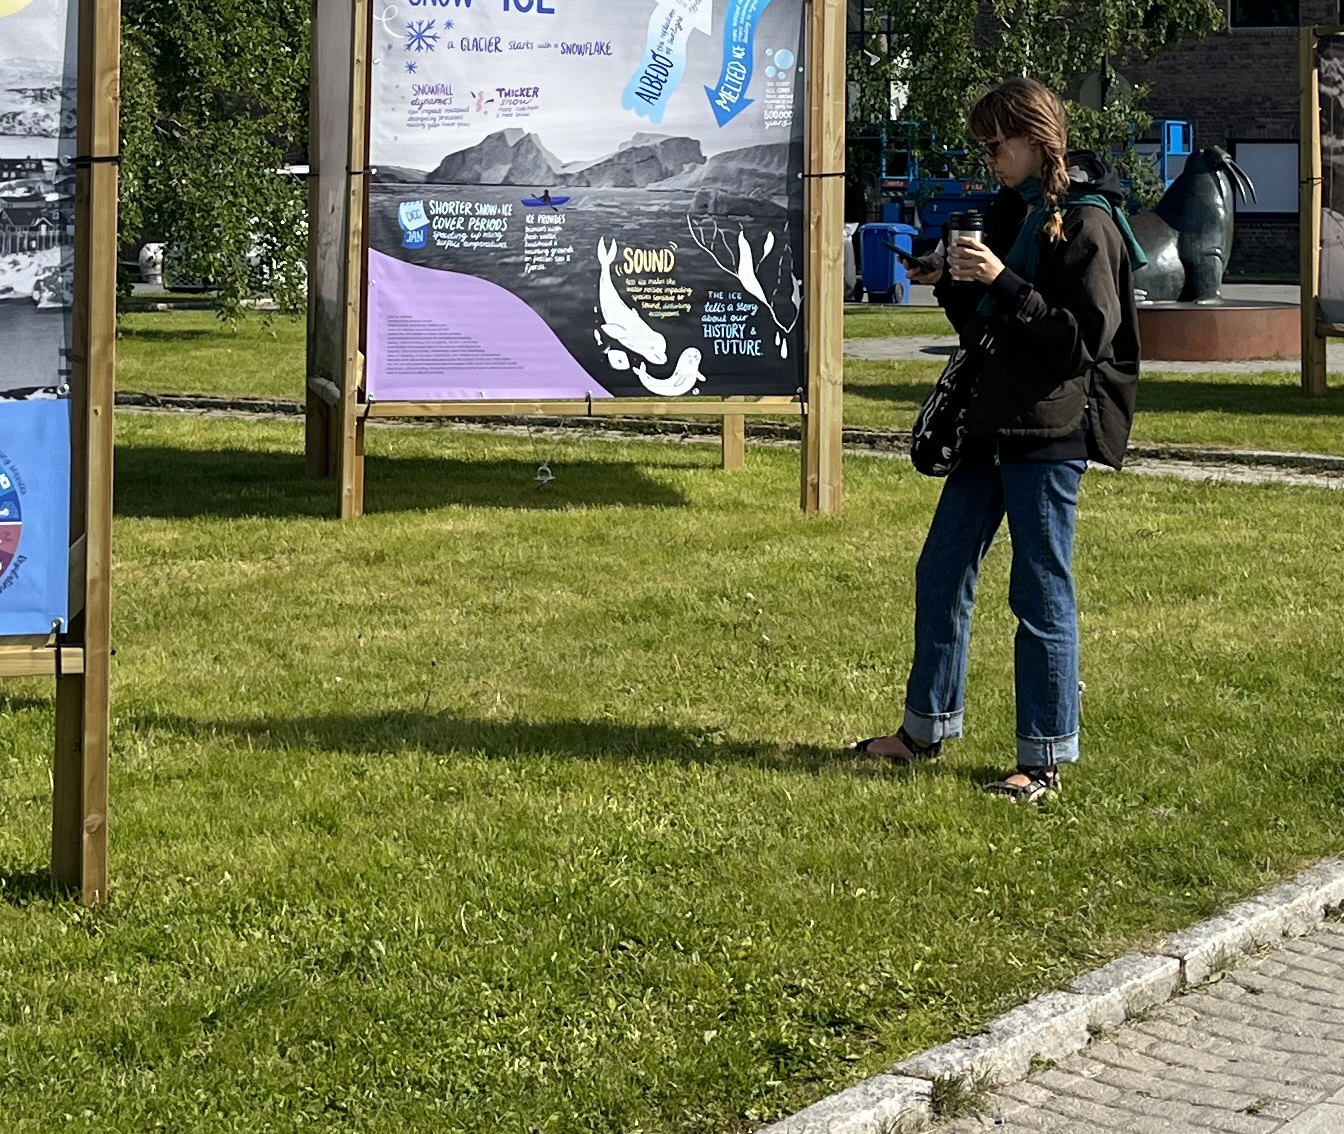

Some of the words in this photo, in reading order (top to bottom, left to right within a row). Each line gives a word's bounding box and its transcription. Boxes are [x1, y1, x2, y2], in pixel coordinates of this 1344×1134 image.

[447, 41, 456, 50] a
[460, 37, 503, 54] GLACIER
[508, 39, 535, 51] starts
[560, 41, 613, 56] SNOWFLAKE
[635, 49, 674, 106] ALBEDO
[412, 83, 453, 97] SNOWFALL
[496, 87, 539, 98] THICKER
[714, 61, 747, 112] MELTED
[500, 98, 533, 106] snow
[429, 200, 472, 216] SHORTER
[475, 203, 498, 216] SNOW
[502, 203, 513, 216] ICE
[406, 209, 422, 222] DEC
[526, 214, 535, 224] ICE
[432, 216, 464, 230] COVER
[468, 217, 507, 232] PERIODS
[406, 230, 424, 243] JAN
[624, 247, 674, 274] SOUND
[708, 290, 723, 300] THE
[728, 291, 742, 300] ICE
[704, 302, 726, 313] tells
[736, 302, 759, 316] story
[701, 314, 726, 322] about
[702, 323, 746, 338] HISTORY
[750, 326, 756, 335] &
